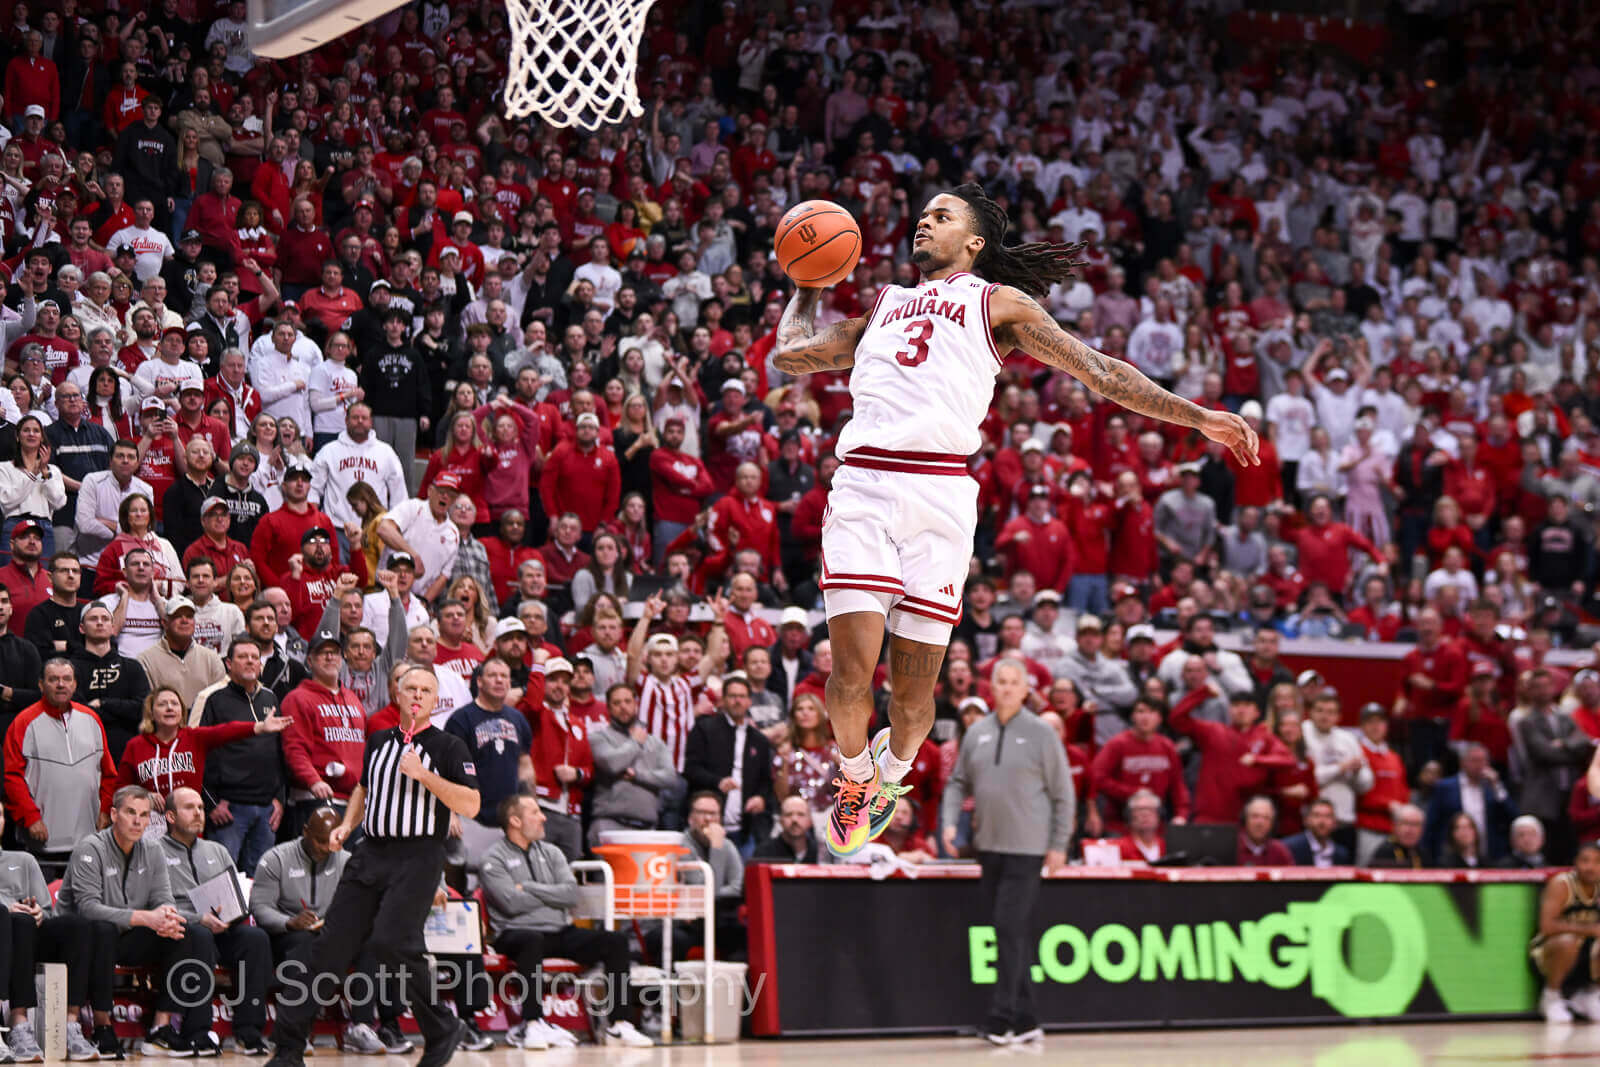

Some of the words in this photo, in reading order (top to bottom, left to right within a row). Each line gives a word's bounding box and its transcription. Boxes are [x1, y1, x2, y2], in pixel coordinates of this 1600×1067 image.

[879, 297, 966, 329] INDIANA
[895, 318, 934, 367] 3
[338, 455, 379, 475] INDIANA
[226, 499, 262, 515] URDUE
[317, 703, 362, 718] INDIANA
[137, 751, 197, 783] INDIANA
[648, 855, 667, 879] G
[968, 883, 1534, 1019] BOOMINGTON
